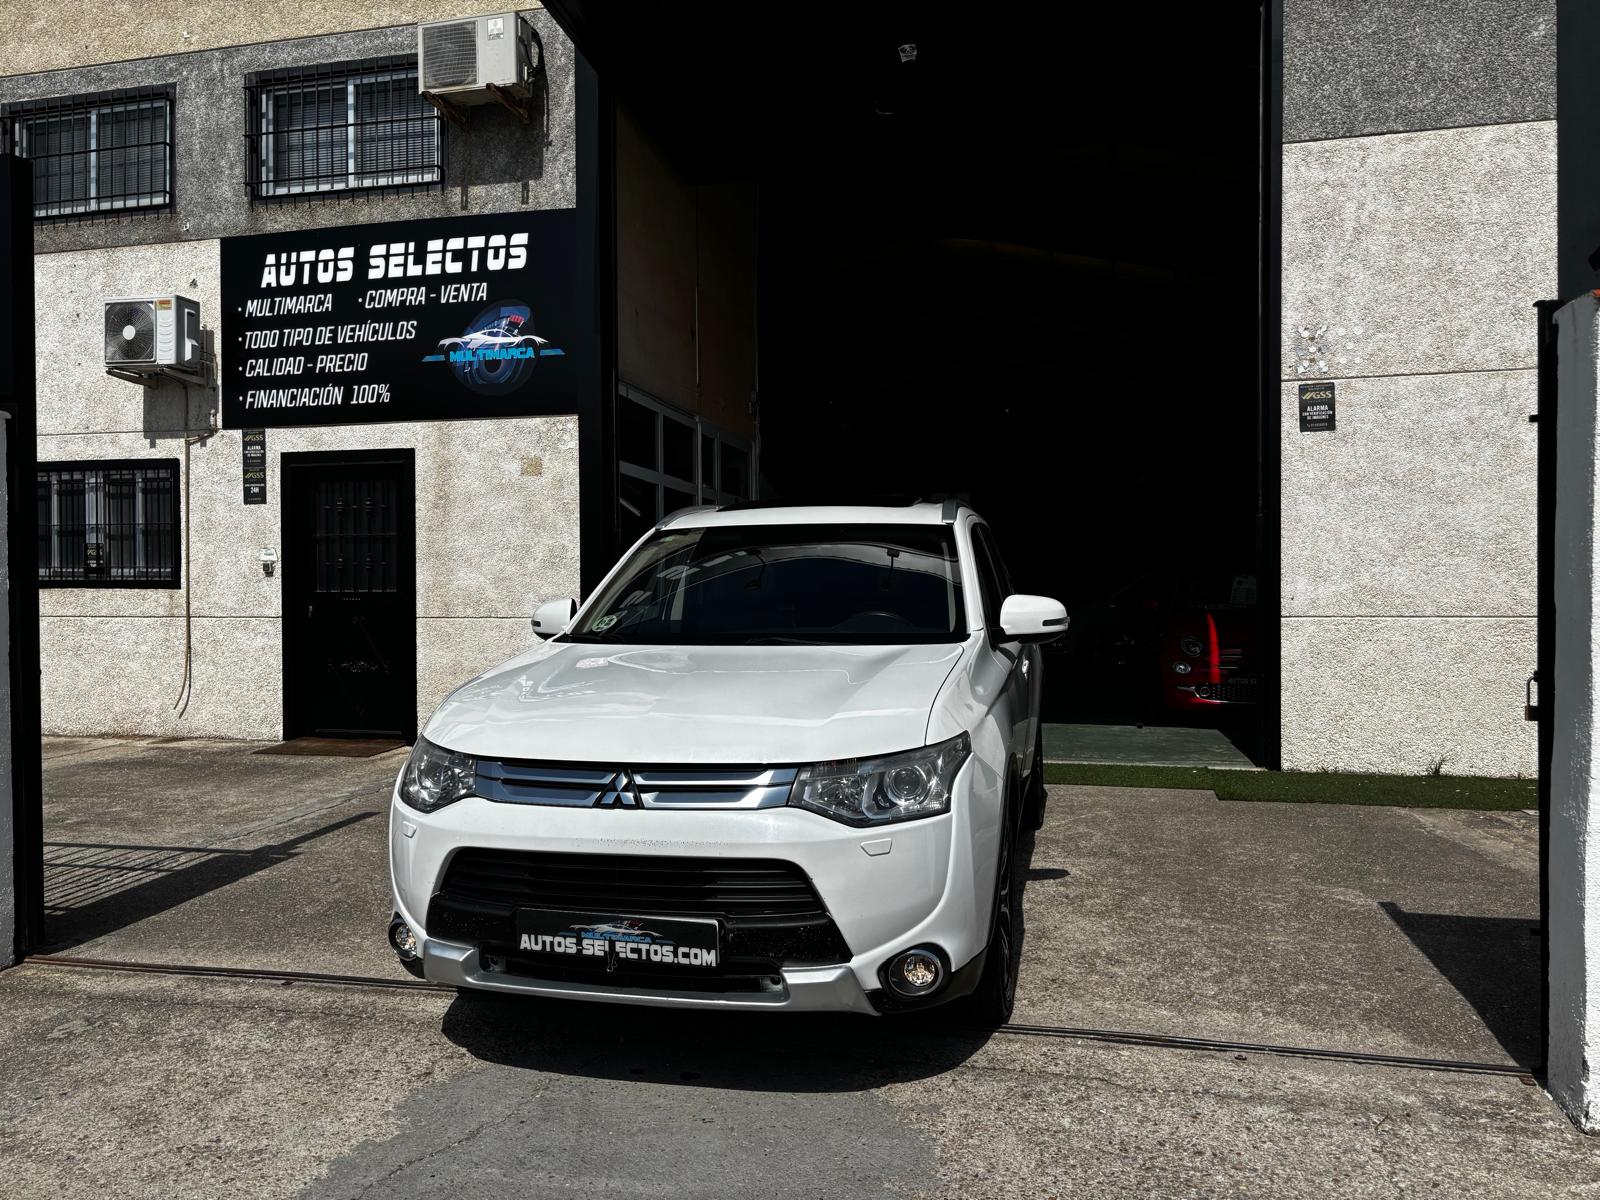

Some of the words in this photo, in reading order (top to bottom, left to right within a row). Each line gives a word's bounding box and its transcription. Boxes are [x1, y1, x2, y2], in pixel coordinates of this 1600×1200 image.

[261, 246, 355, 288] AUTOS
[367, 233, 529, 279] SELECTOS
[245, 294, 332, 317] MULTIMARCA
[365, 286, 426, 309] COMPRA
[440, 282, 488, 304] VENTA
[245, 329, 280, 349] TODO
[282, 326, 313, 347] TIPO
[315, 325, 335, 345] DE
[337, 319, 417, 344] VEHÍCULOS
[245, 357, 304, 378] CALIDAD
[316, 352, 369, 374] PRECIO
[450, 347, 535, 362] MULTIMARCA
[245, 383, 343, 409] FINANCIACIÓN
[350, 384, 391, 405] 100%
